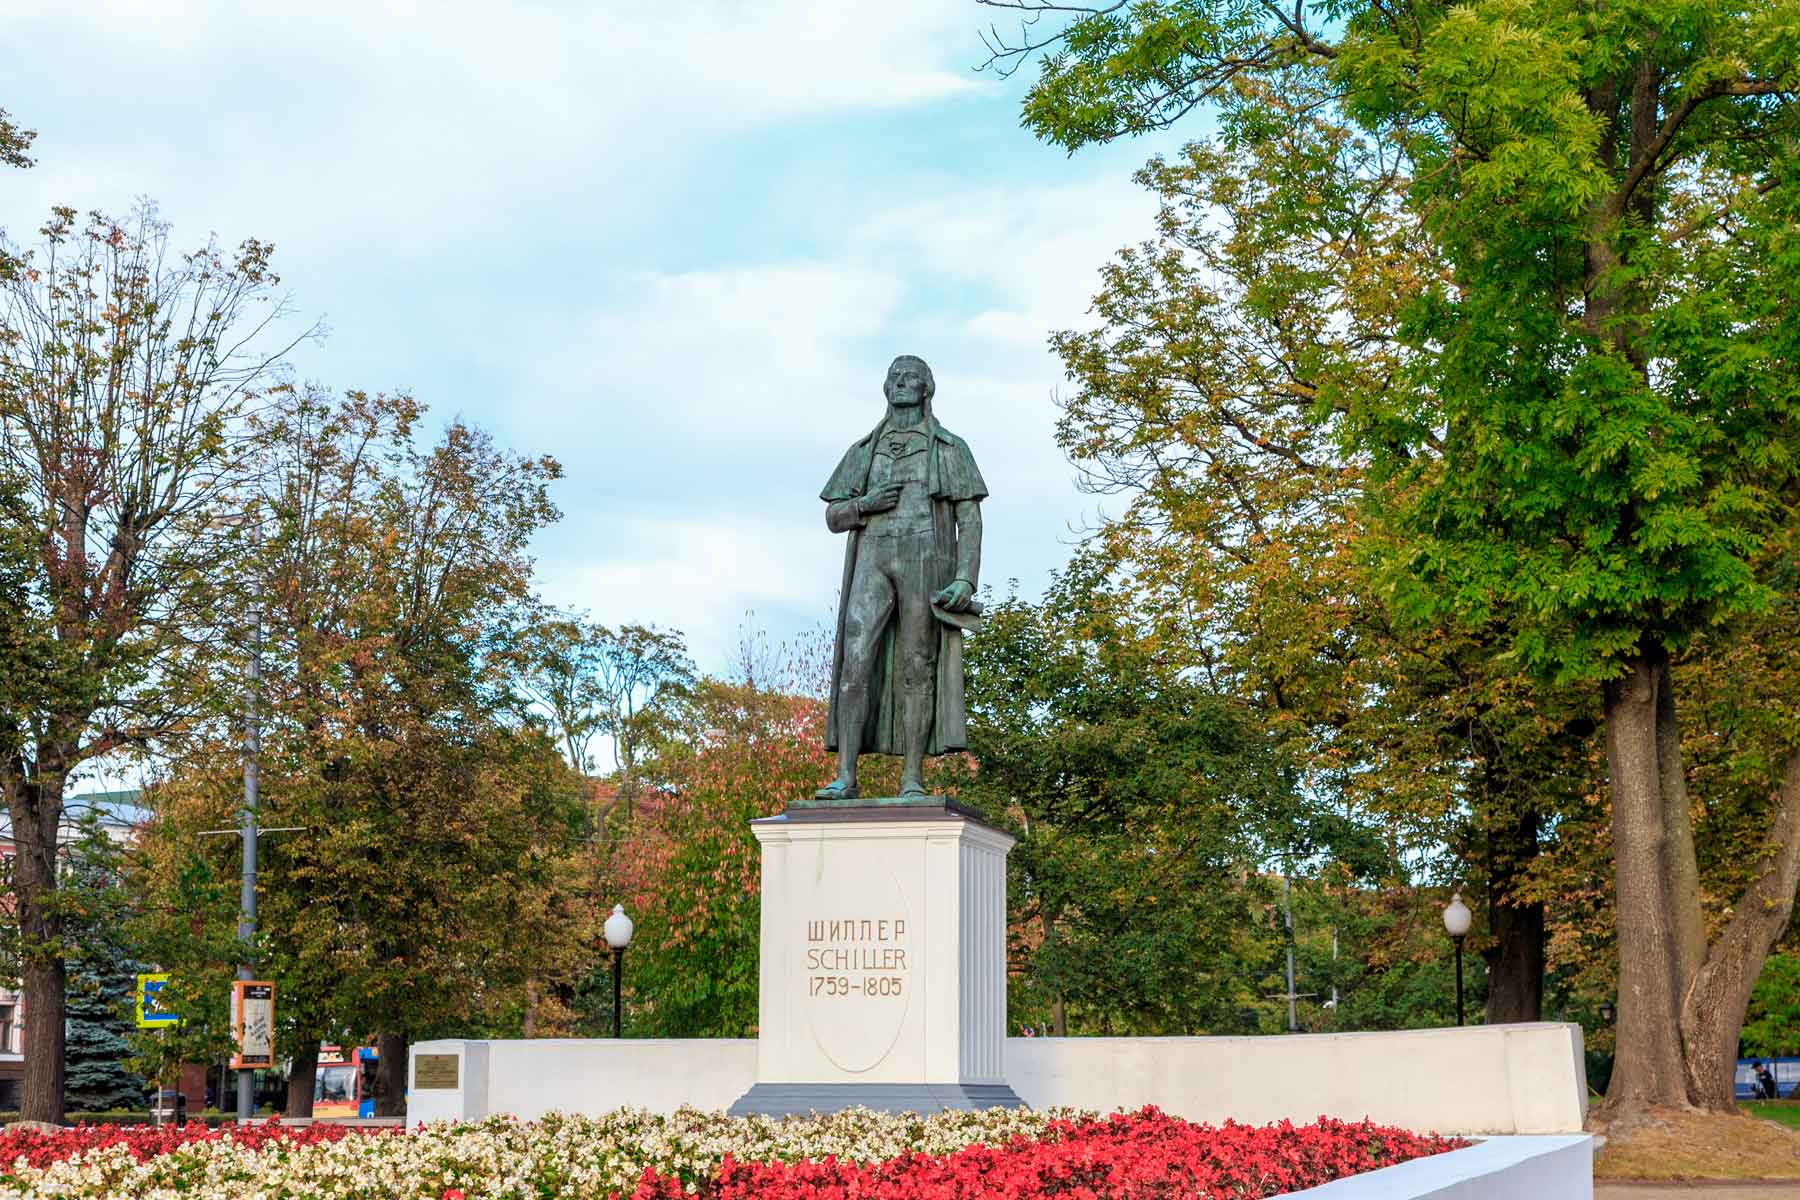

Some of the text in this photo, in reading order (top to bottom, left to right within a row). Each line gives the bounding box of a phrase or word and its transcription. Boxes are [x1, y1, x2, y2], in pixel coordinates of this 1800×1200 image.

[807, 919, 905, 941] ШИЛЛЕР
[807, 948, 908, 970] SCHILLER
[809, 976, 903, 997] 1759-1805
